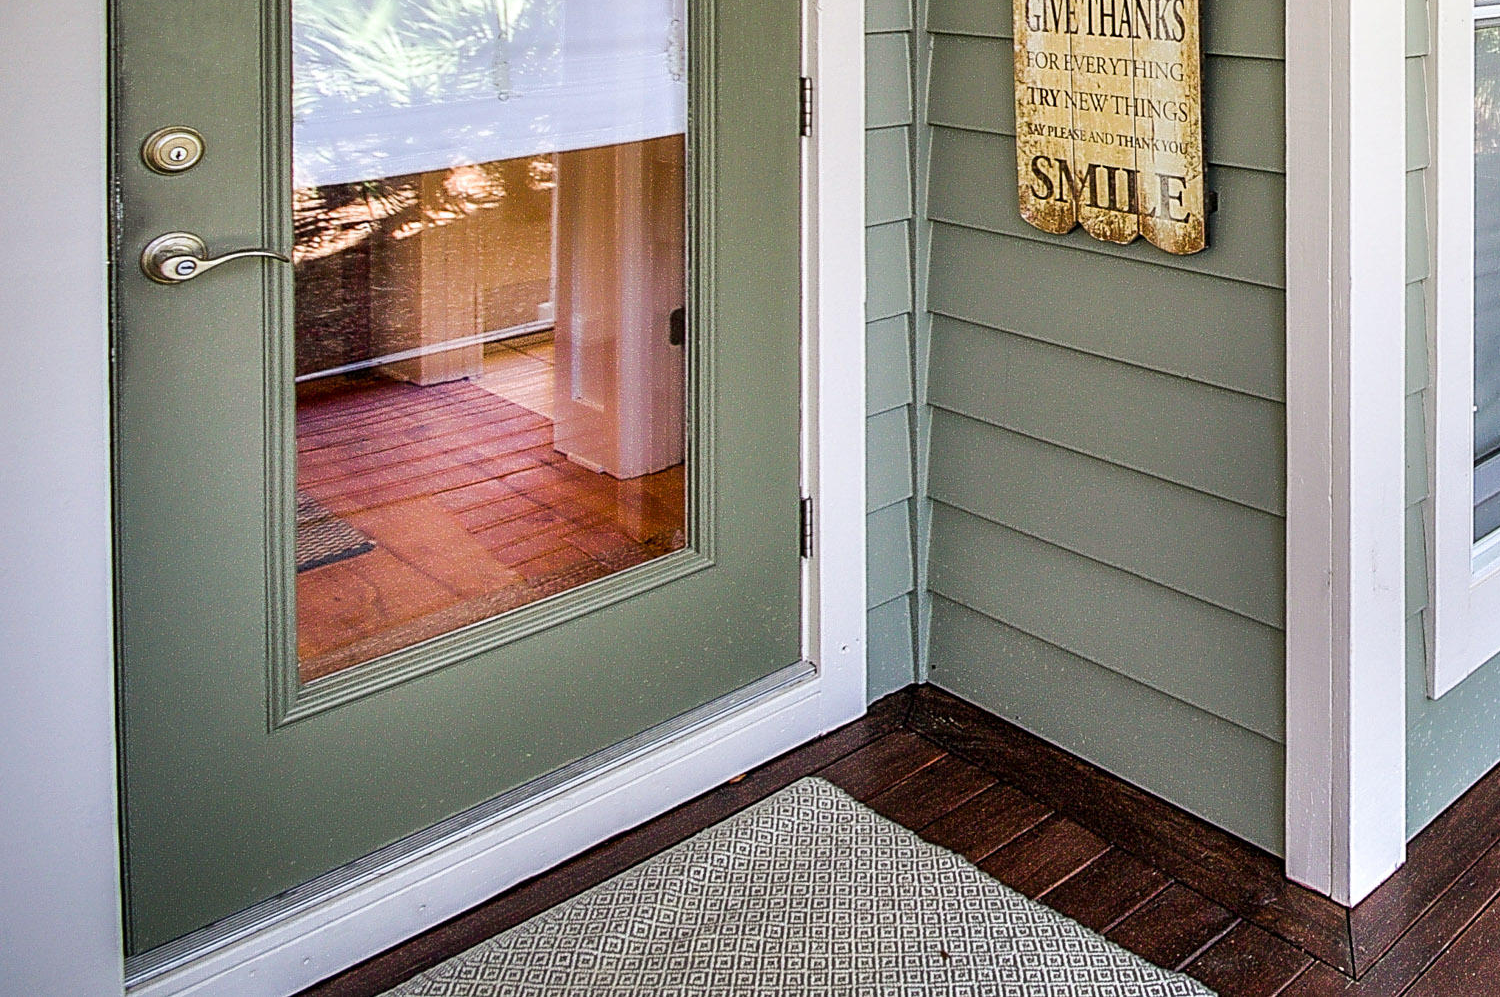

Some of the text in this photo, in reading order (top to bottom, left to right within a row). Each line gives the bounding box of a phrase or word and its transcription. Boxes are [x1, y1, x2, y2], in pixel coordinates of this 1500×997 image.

[1027, 51, 1184, 82] FOR EVERYTHING
[1027, 87, 1188, 123] TRY NEW THINGS
[1028, 123, 1188, 154] SAY PLEASE AND THANK YOU
[1030, 155, 1190, 224] SMILE
